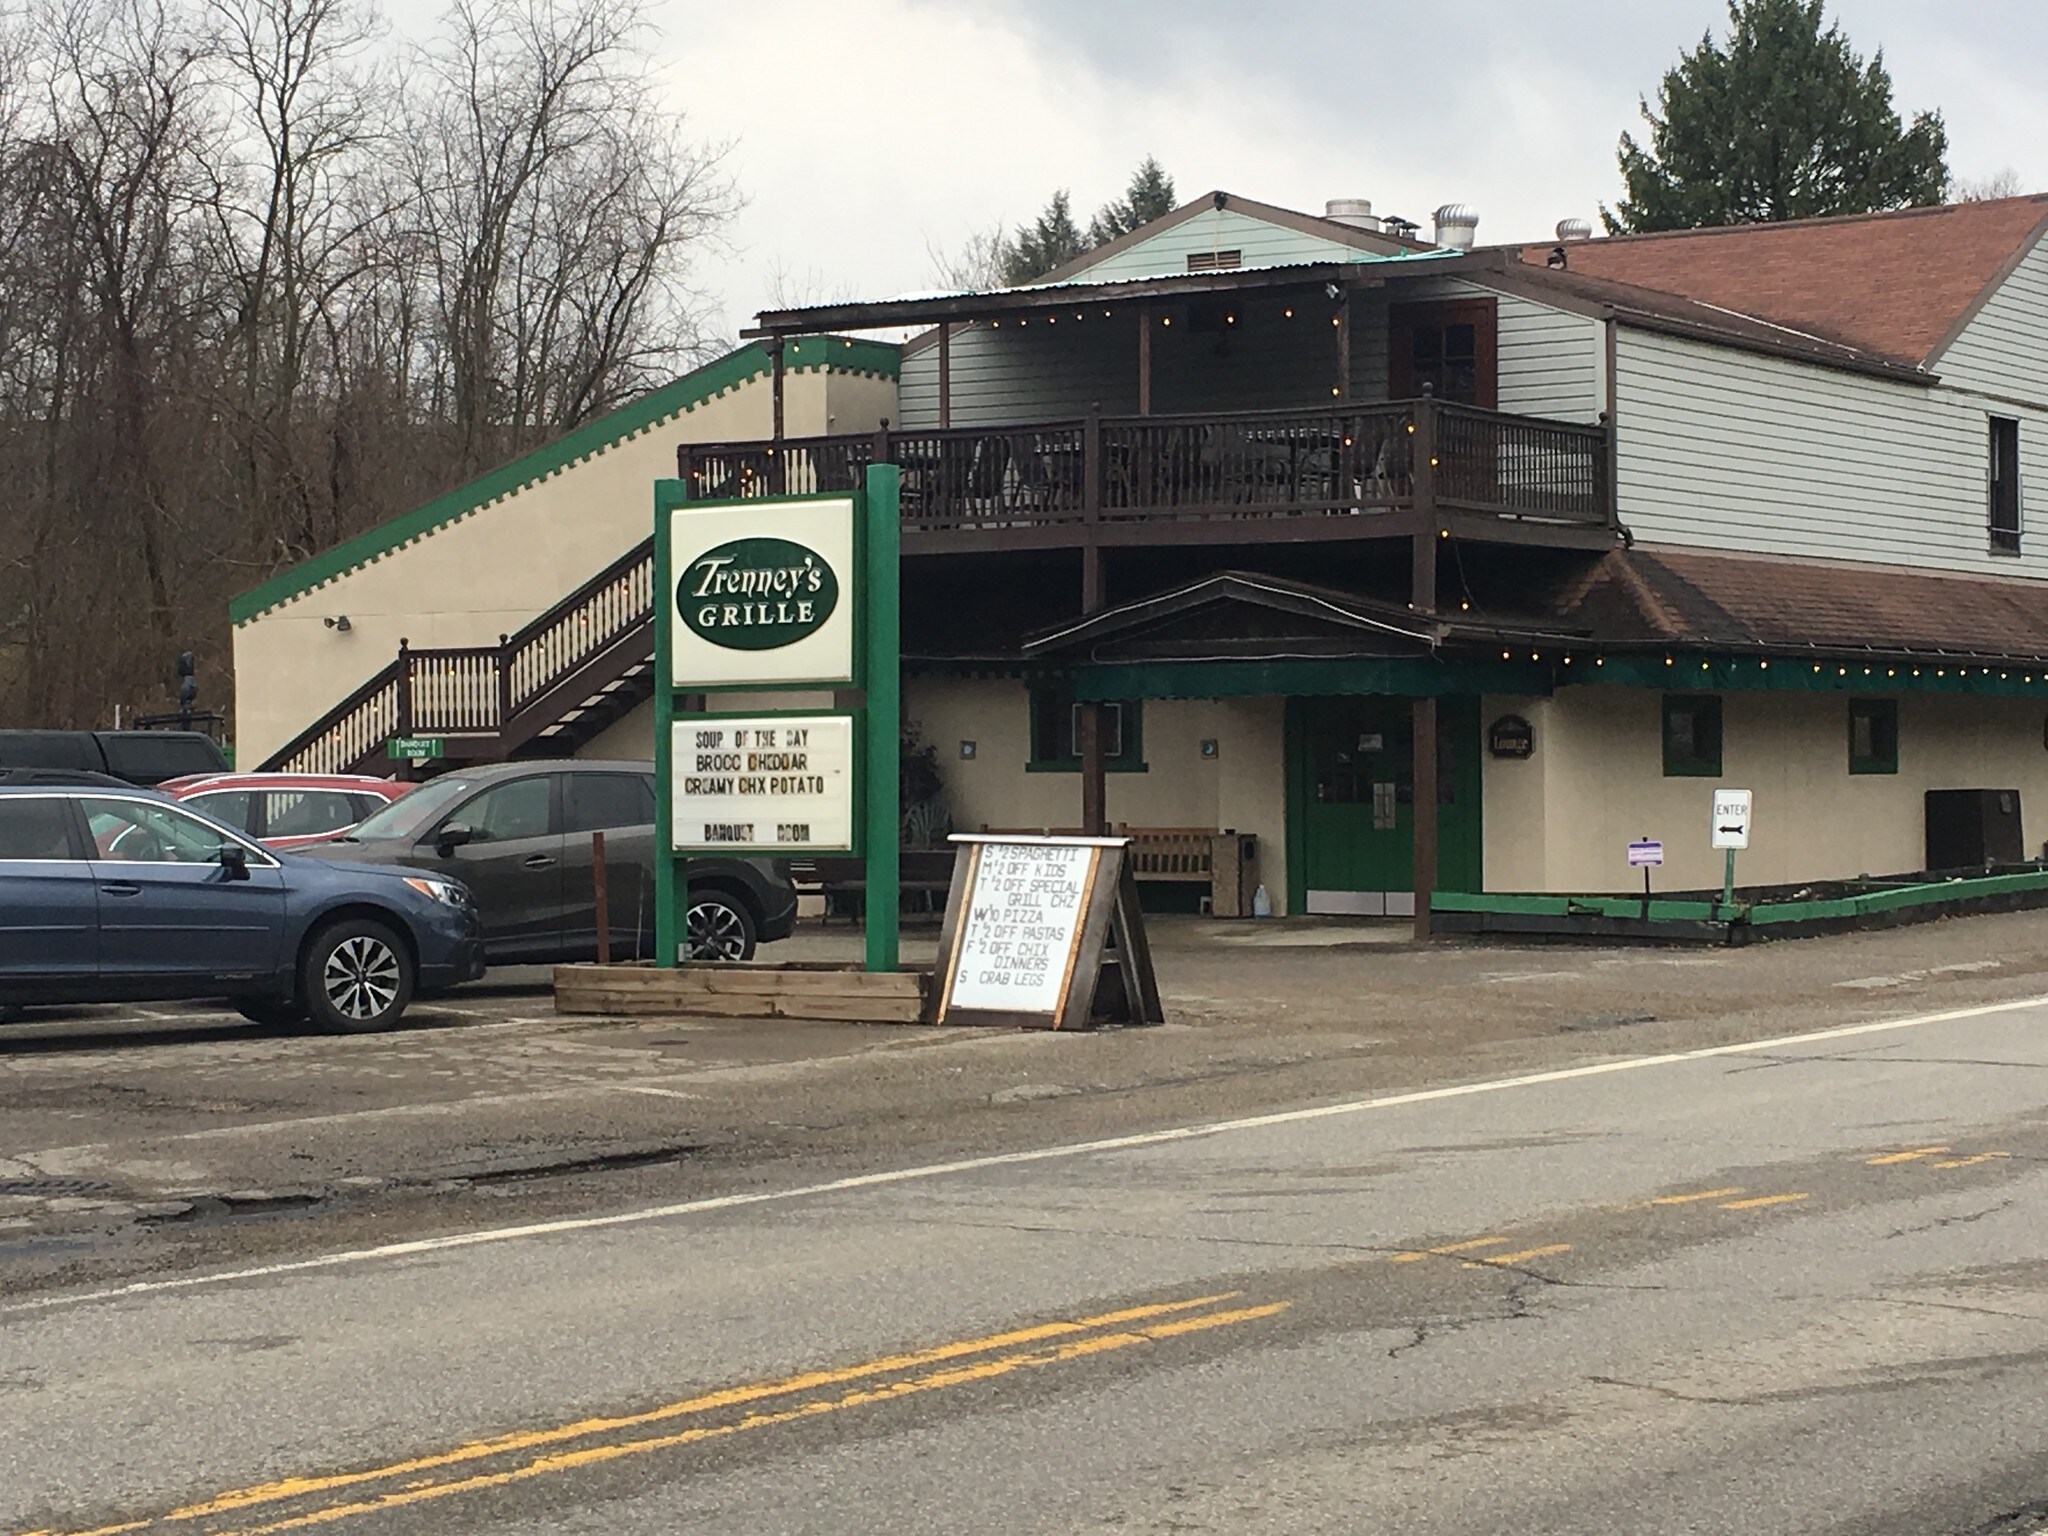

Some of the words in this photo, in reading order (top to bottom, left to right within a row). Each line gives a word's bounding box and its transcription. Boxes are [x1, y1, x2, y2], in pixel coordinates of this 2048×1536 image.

[692, 554, 822, 599] Trenney's
[698, 601, 815, 627] GRILLE
[696, 731, 723, 749] SOUP
[735, 731, 748, 748] OF
[755, 730, 776, 747] THE
[696, 754, 741, 772] BROCC
[748, 753, 808, 771] CHEDDAR
[685, 777, 734, 794] CREAMY
[739, 776, 766, 794] CHX
[771, 776, 824, 794] POTATO
[1716, 804, 1747, 816] ENTER
[985, 845, 994, 859] S
[1010, 846, 1079, 862] SPAGHETTI
[981, 862, 992, 875] M
[1007, 862, 1030, 876] OFF
[1034, 863, 1067, 877] KIDS
[980, 877, 987, 890] T
[1003, 878, 1026, 892] OFF
[1029, 879, 1080, 895] SPECIAL
[1008, 892, 1042, 907] GRILL
[1050, 894, 1076, 909] CHZ
[1003, 909, 1044, 924] PIZZA
[971, 924, 978, 937] T
[994, 925, 1018, 939] OFF
[1022, 926, 1065, 941] PASTAS
[966, 940, 976, 953] F
[989, 941, 1013, 955] OFF
[1017, 942, 1050, 957] CHIX
[993, 955, 1050, 971] DINNERS
[959, 970, 968, 984] S
[979, 970, 1011, 985] CRAB
[1014, 973, 1045, 987] LEGS
